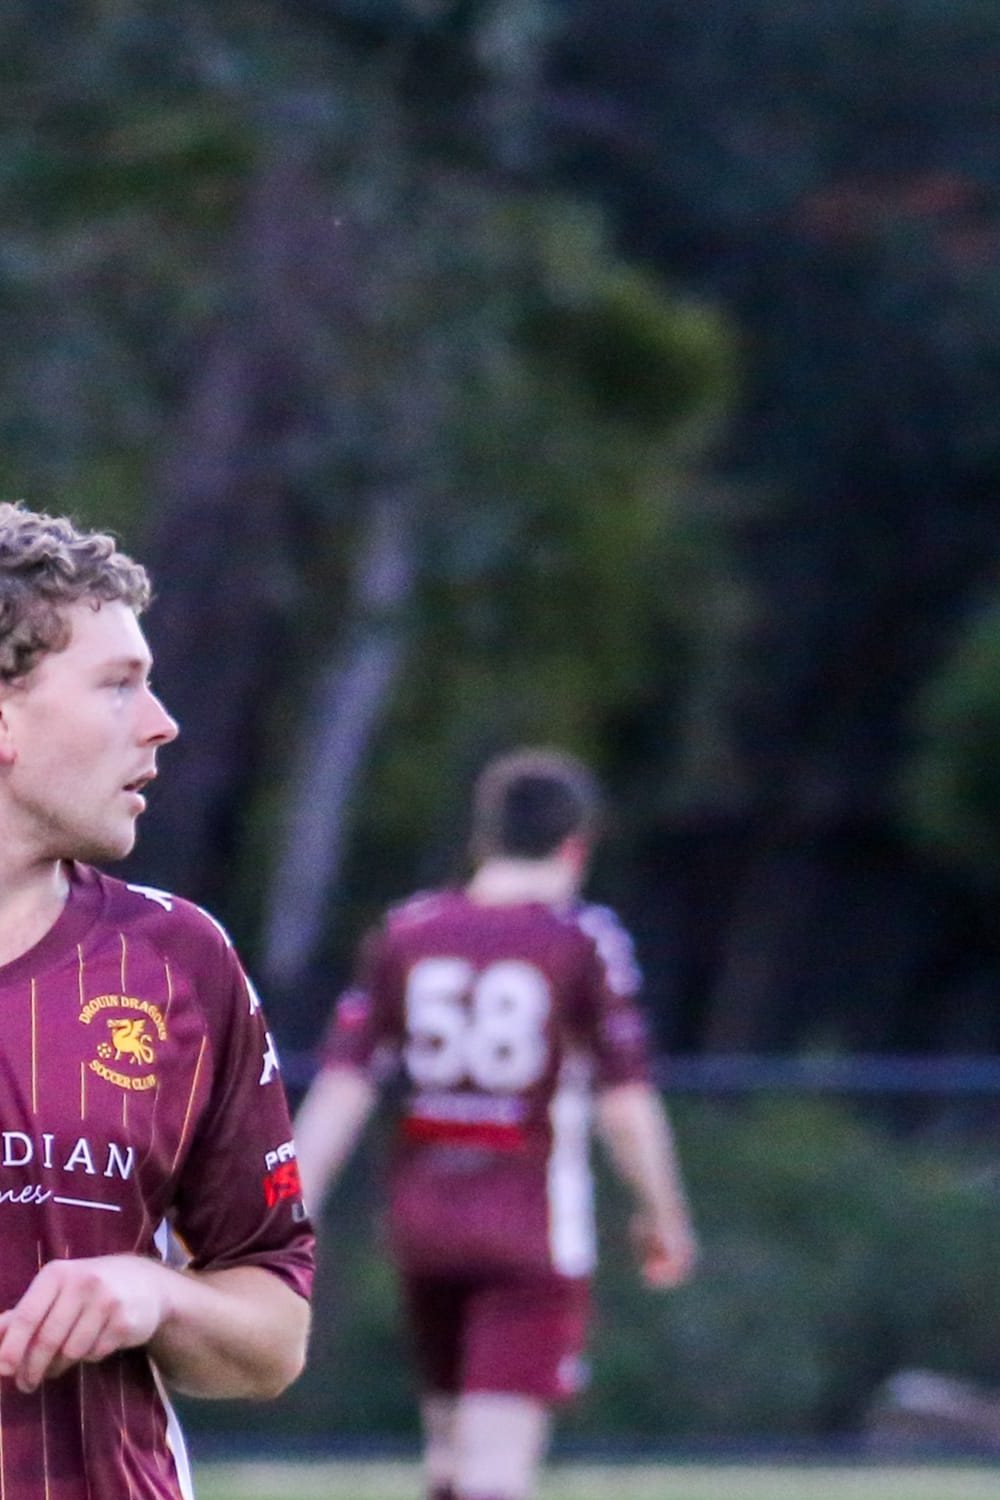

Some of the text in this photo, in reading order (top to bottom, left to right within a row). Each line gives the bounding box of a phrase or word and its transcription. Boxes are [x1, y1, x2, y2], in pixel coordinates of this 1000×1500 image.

[79, 994, 119, 1025] DROUIN
[405, 955, 551, 1092] 58
[89, 1059, 131, 1089] SOCCER
